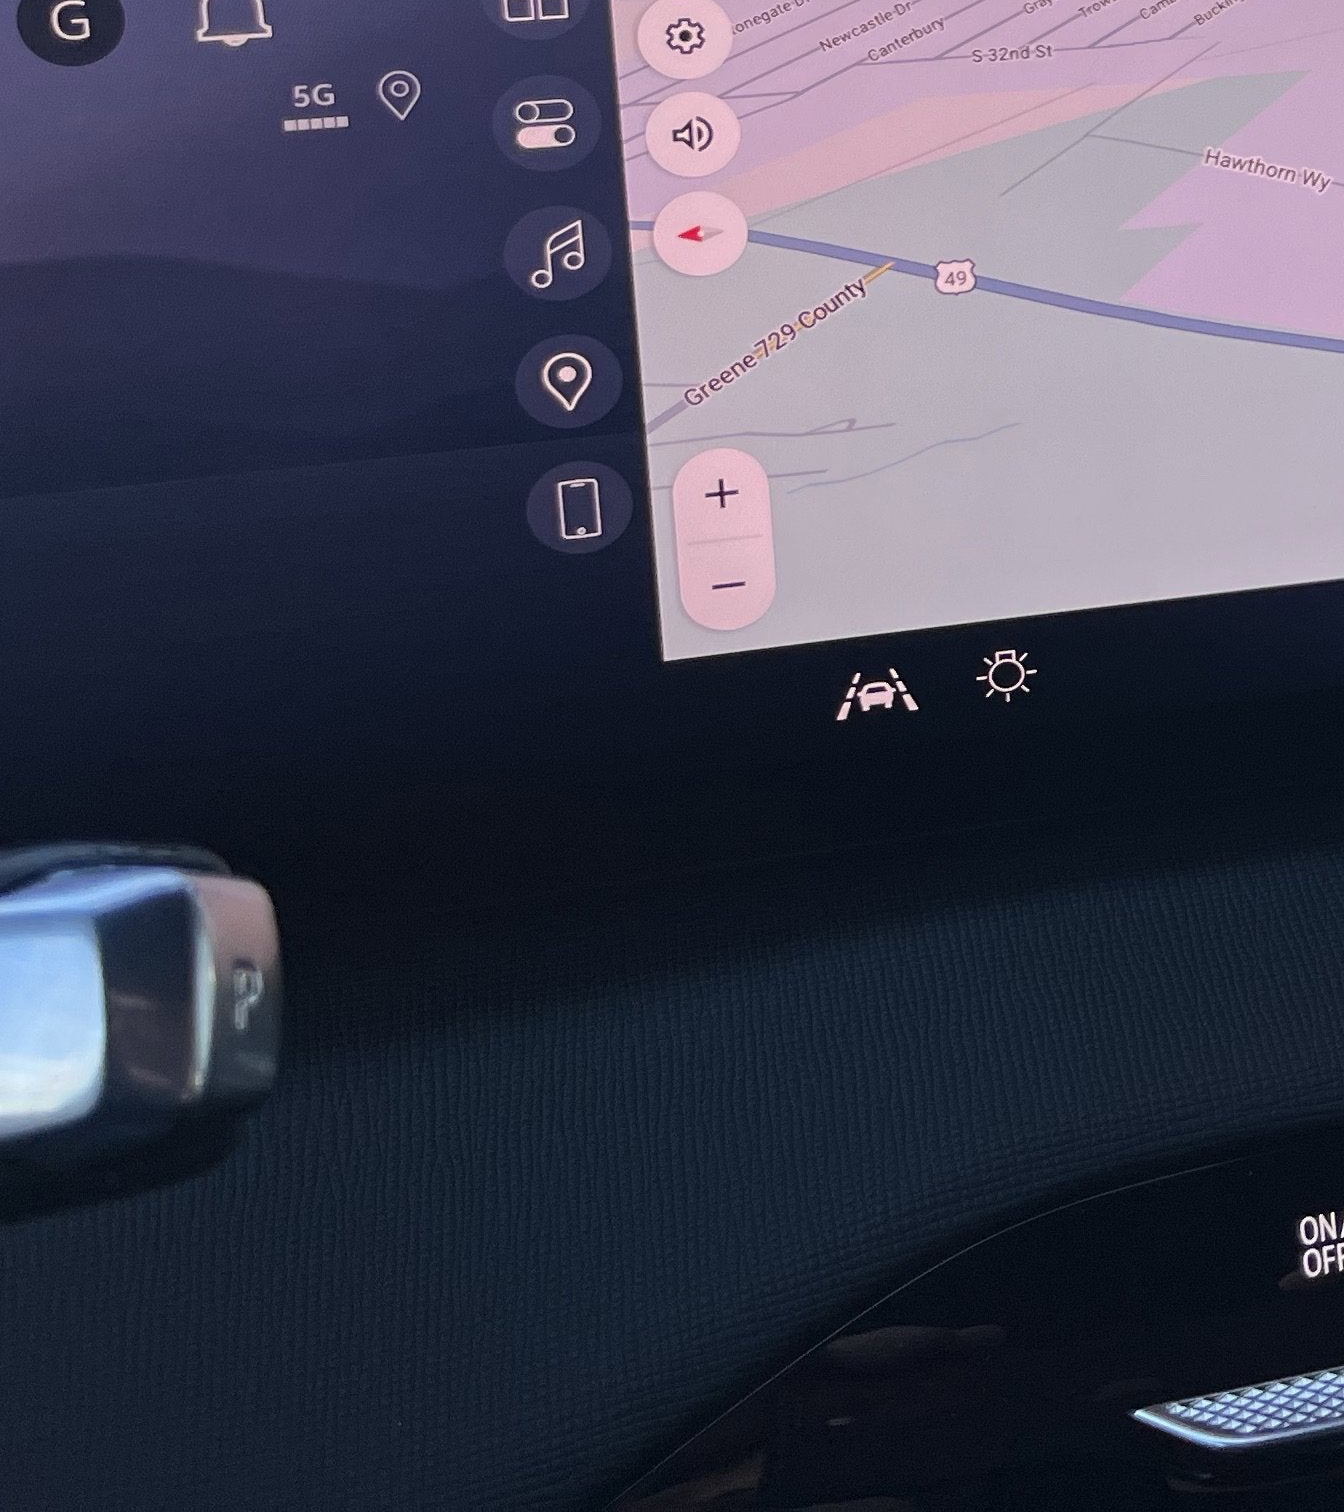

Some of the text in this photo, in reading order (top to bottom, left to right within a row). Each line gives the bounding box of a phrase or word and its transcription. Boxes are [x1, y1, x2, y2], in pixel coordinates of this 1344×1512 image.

[51, 0, 91, 40] G
[819, 0, 912, 52] Newcastle Dr
[867, 17, 946, 62] Canterbury
[972, 43, 1053, 63] S 32nd St
[293, 83, 336, 108] 5G
[1205, 148, 1331, 193] Hawthorn Wy
[944, 270, 967, 287] 49
[684, 278, 868, 406] Greene 729 County
